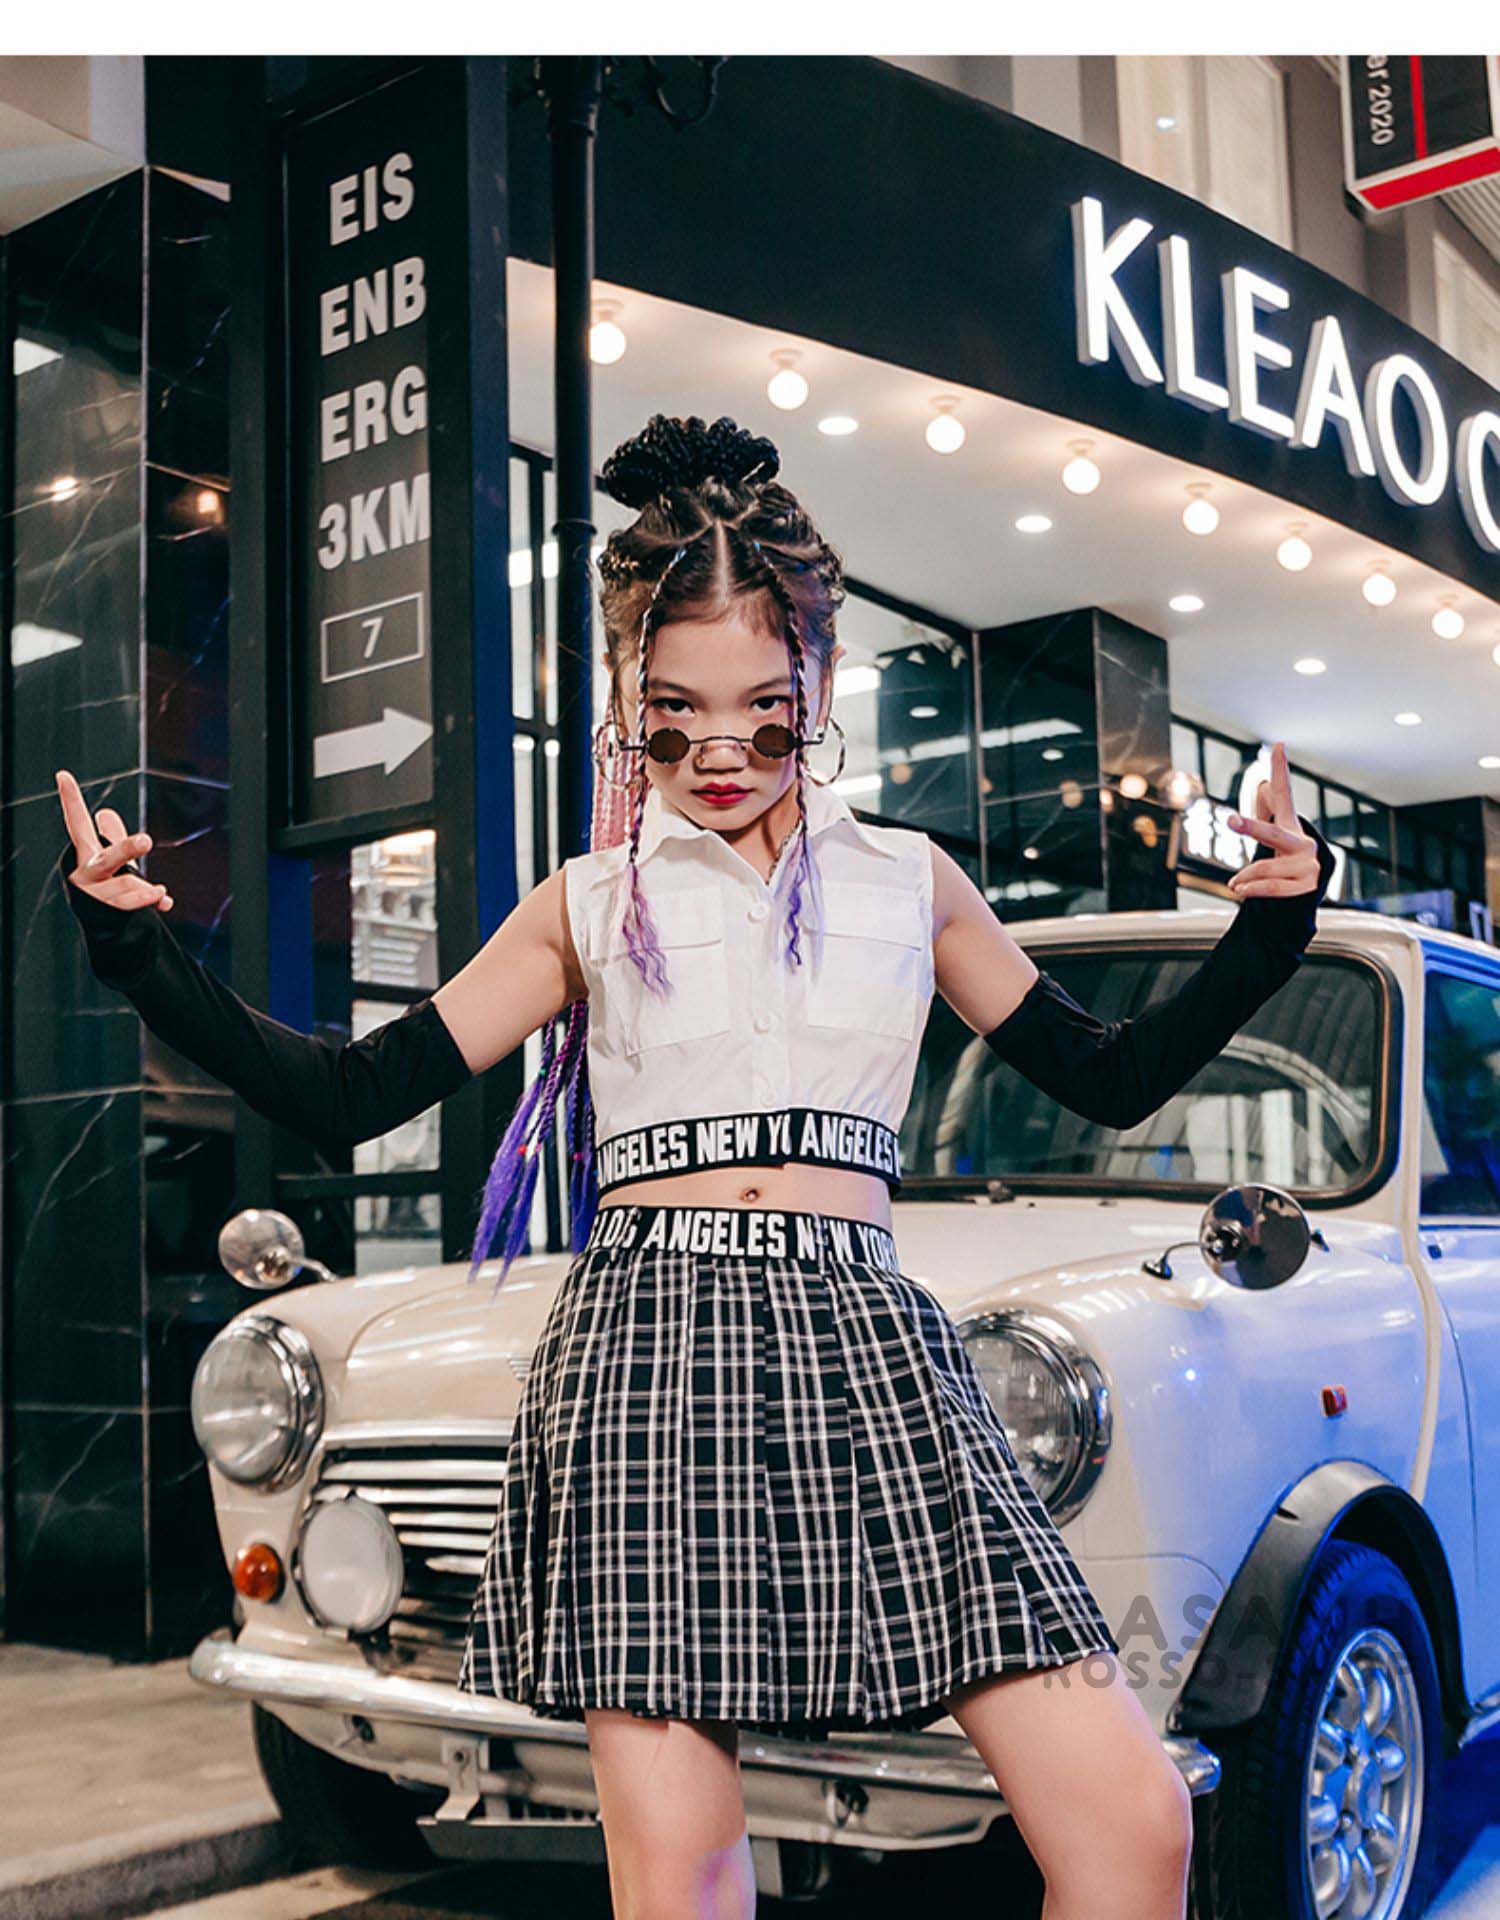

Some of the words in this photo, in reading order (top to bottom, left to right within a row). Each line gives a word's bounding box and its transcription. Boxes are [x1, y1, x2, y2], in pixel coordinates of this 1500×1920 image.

[1368, 84, 1395, 145] 2020
[330, 152, 414, 246] EIS
[320, 257, 426, 356] ENB
[321, 364, 428, 463] ERG
[318, 473, 430, 571] 3KM
[361, 618, 381, 659] 7
[597, 1124, 689, 1189] NGELES
[696, 1116, 759, 1165] NEW
[800, 1112, 894, 1175] ANGELES
[641, 1209, 785, 1259] ANGELES
